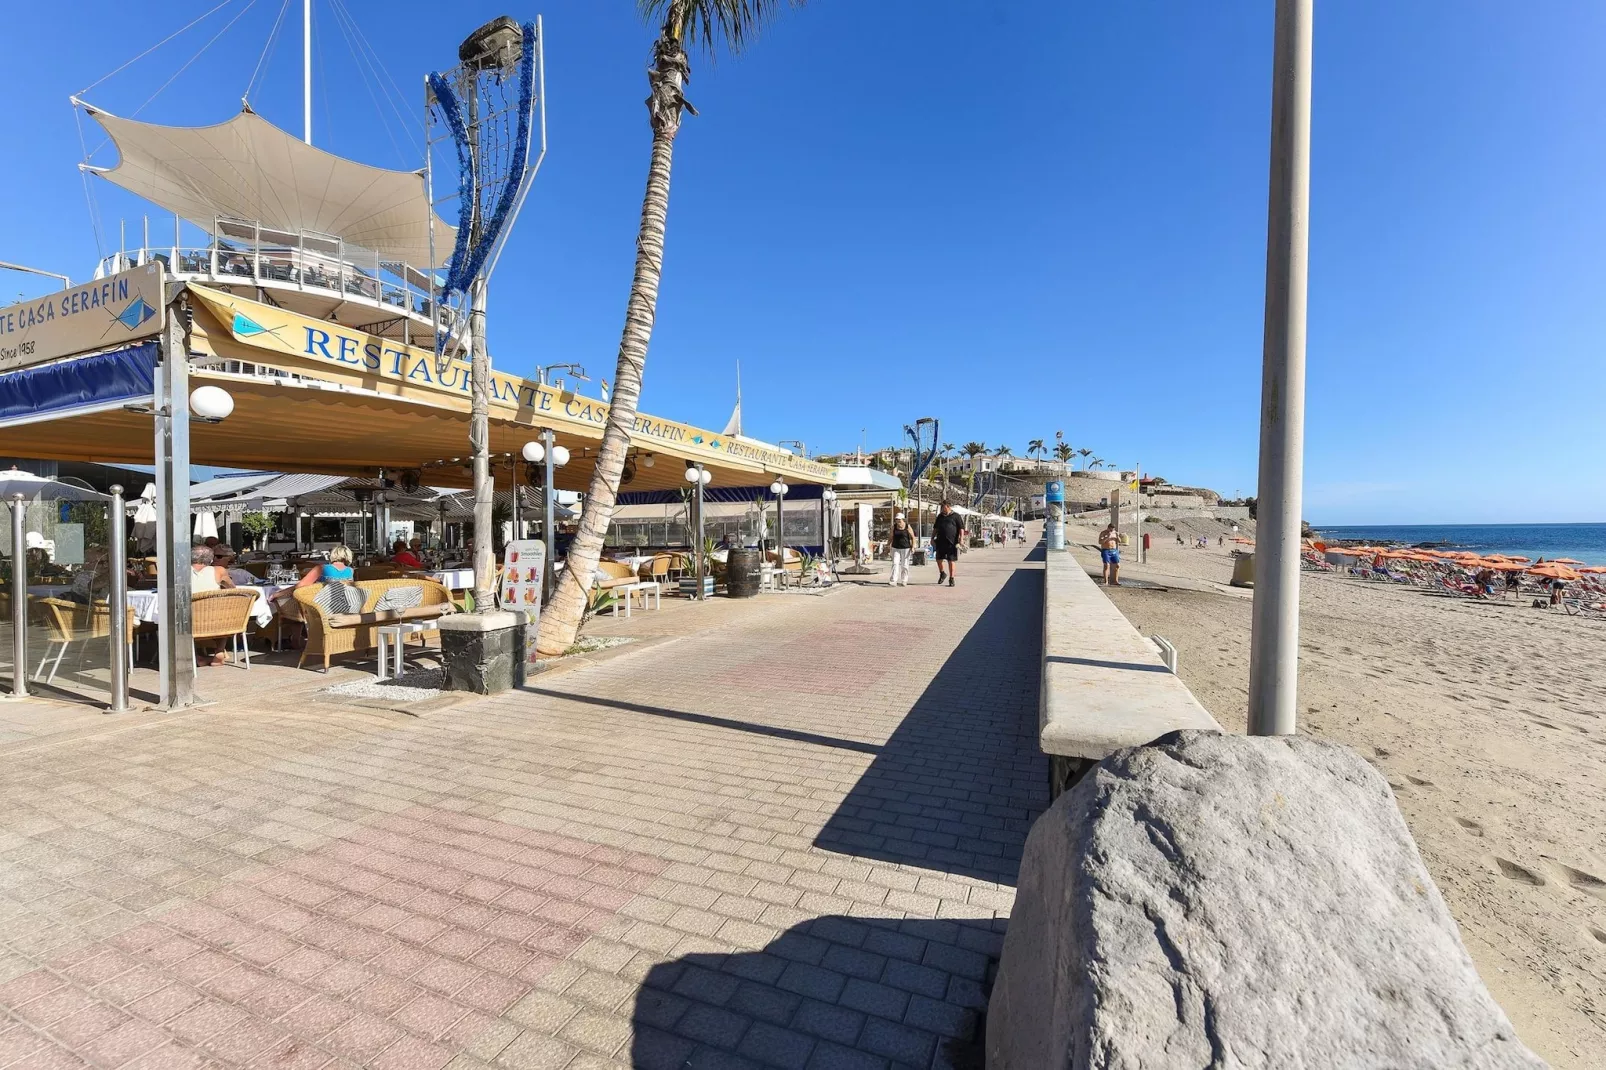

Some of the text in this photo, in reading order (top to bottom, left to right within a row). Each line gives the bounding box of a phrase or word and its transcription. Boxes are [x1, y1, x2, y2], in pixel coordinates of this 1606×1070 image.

[19, 302, 55, 328] CASA
[61, 276, 129, 317] SERAFÍN
[0, 340, 36, 361] Since 1958
[565, 398, 608, 426] CAS
[726, 441, 787, 466] RESTAURANTE
[789, 458, 806, 472] CASA
